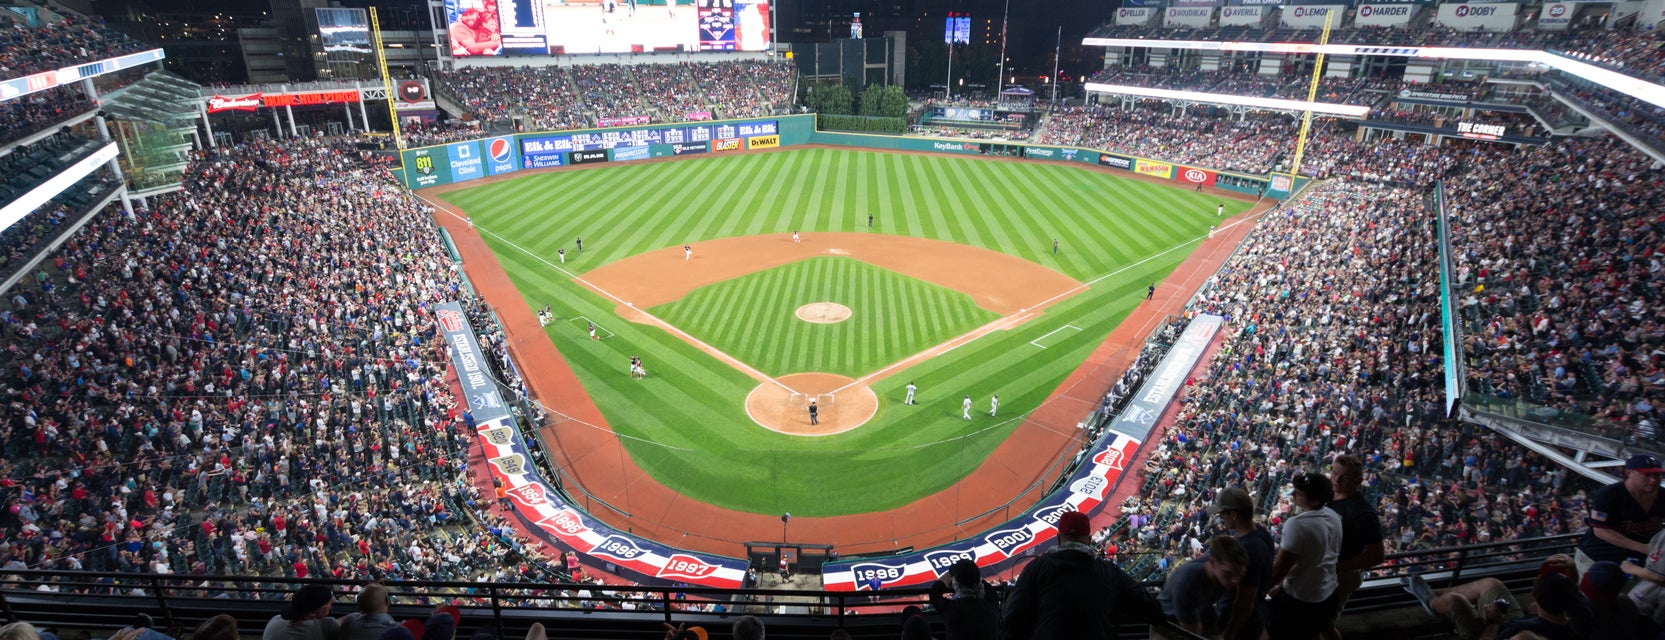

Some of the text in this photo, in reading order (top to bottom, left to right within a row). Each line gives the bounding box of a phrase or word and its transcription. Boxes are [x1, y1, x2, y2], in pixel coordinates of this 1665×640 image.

[1372, 7, 1408, 16] HARDER
[1469, 7, 1496, 15] DOBY
[298, 93, 322, 105] RUN
[739, 126, 752, 135] Elk
[753, 126, 761, 134] &
[762, 124, 776, 133] Elk
[1457, 122, 1473, 132] THE
[1472, 123, 1506, 136] CORNER
[524, 141, 544, 152] Elk
[544, 141, 554, 150] &
[555, 139, 573, 149] Elk
[934, 142, 963, 150] KeyBank
[416, 156, 432, 170] 811
[451, 157, 481, 168] Cleveland
[495, 163, 512, 173] pepsi
[458, 166, 476, 175] Clinic
[1189, 172, 1202, 180] KIA
[452, 334, 479, 372] ESTABLISHED
[490, 429, 507, 444] 1920
[1101, 449, 1120, 465] 2016
[501, 456, 520, 474] 1948
[1080, 476, 1103, 494] 2013
[518, 485, 542, 504] 1954
[1042, 502, 1076, 524] 2007
[551, 511, 582, 534] 1995
[994, 530, 1033, 549] 2001
[600, 540, 640, 558] 1996
[667, 559, 710, 576] 1997
[932, 553, 972, 568] 1999
[857, 568, 899, 582] 1998
